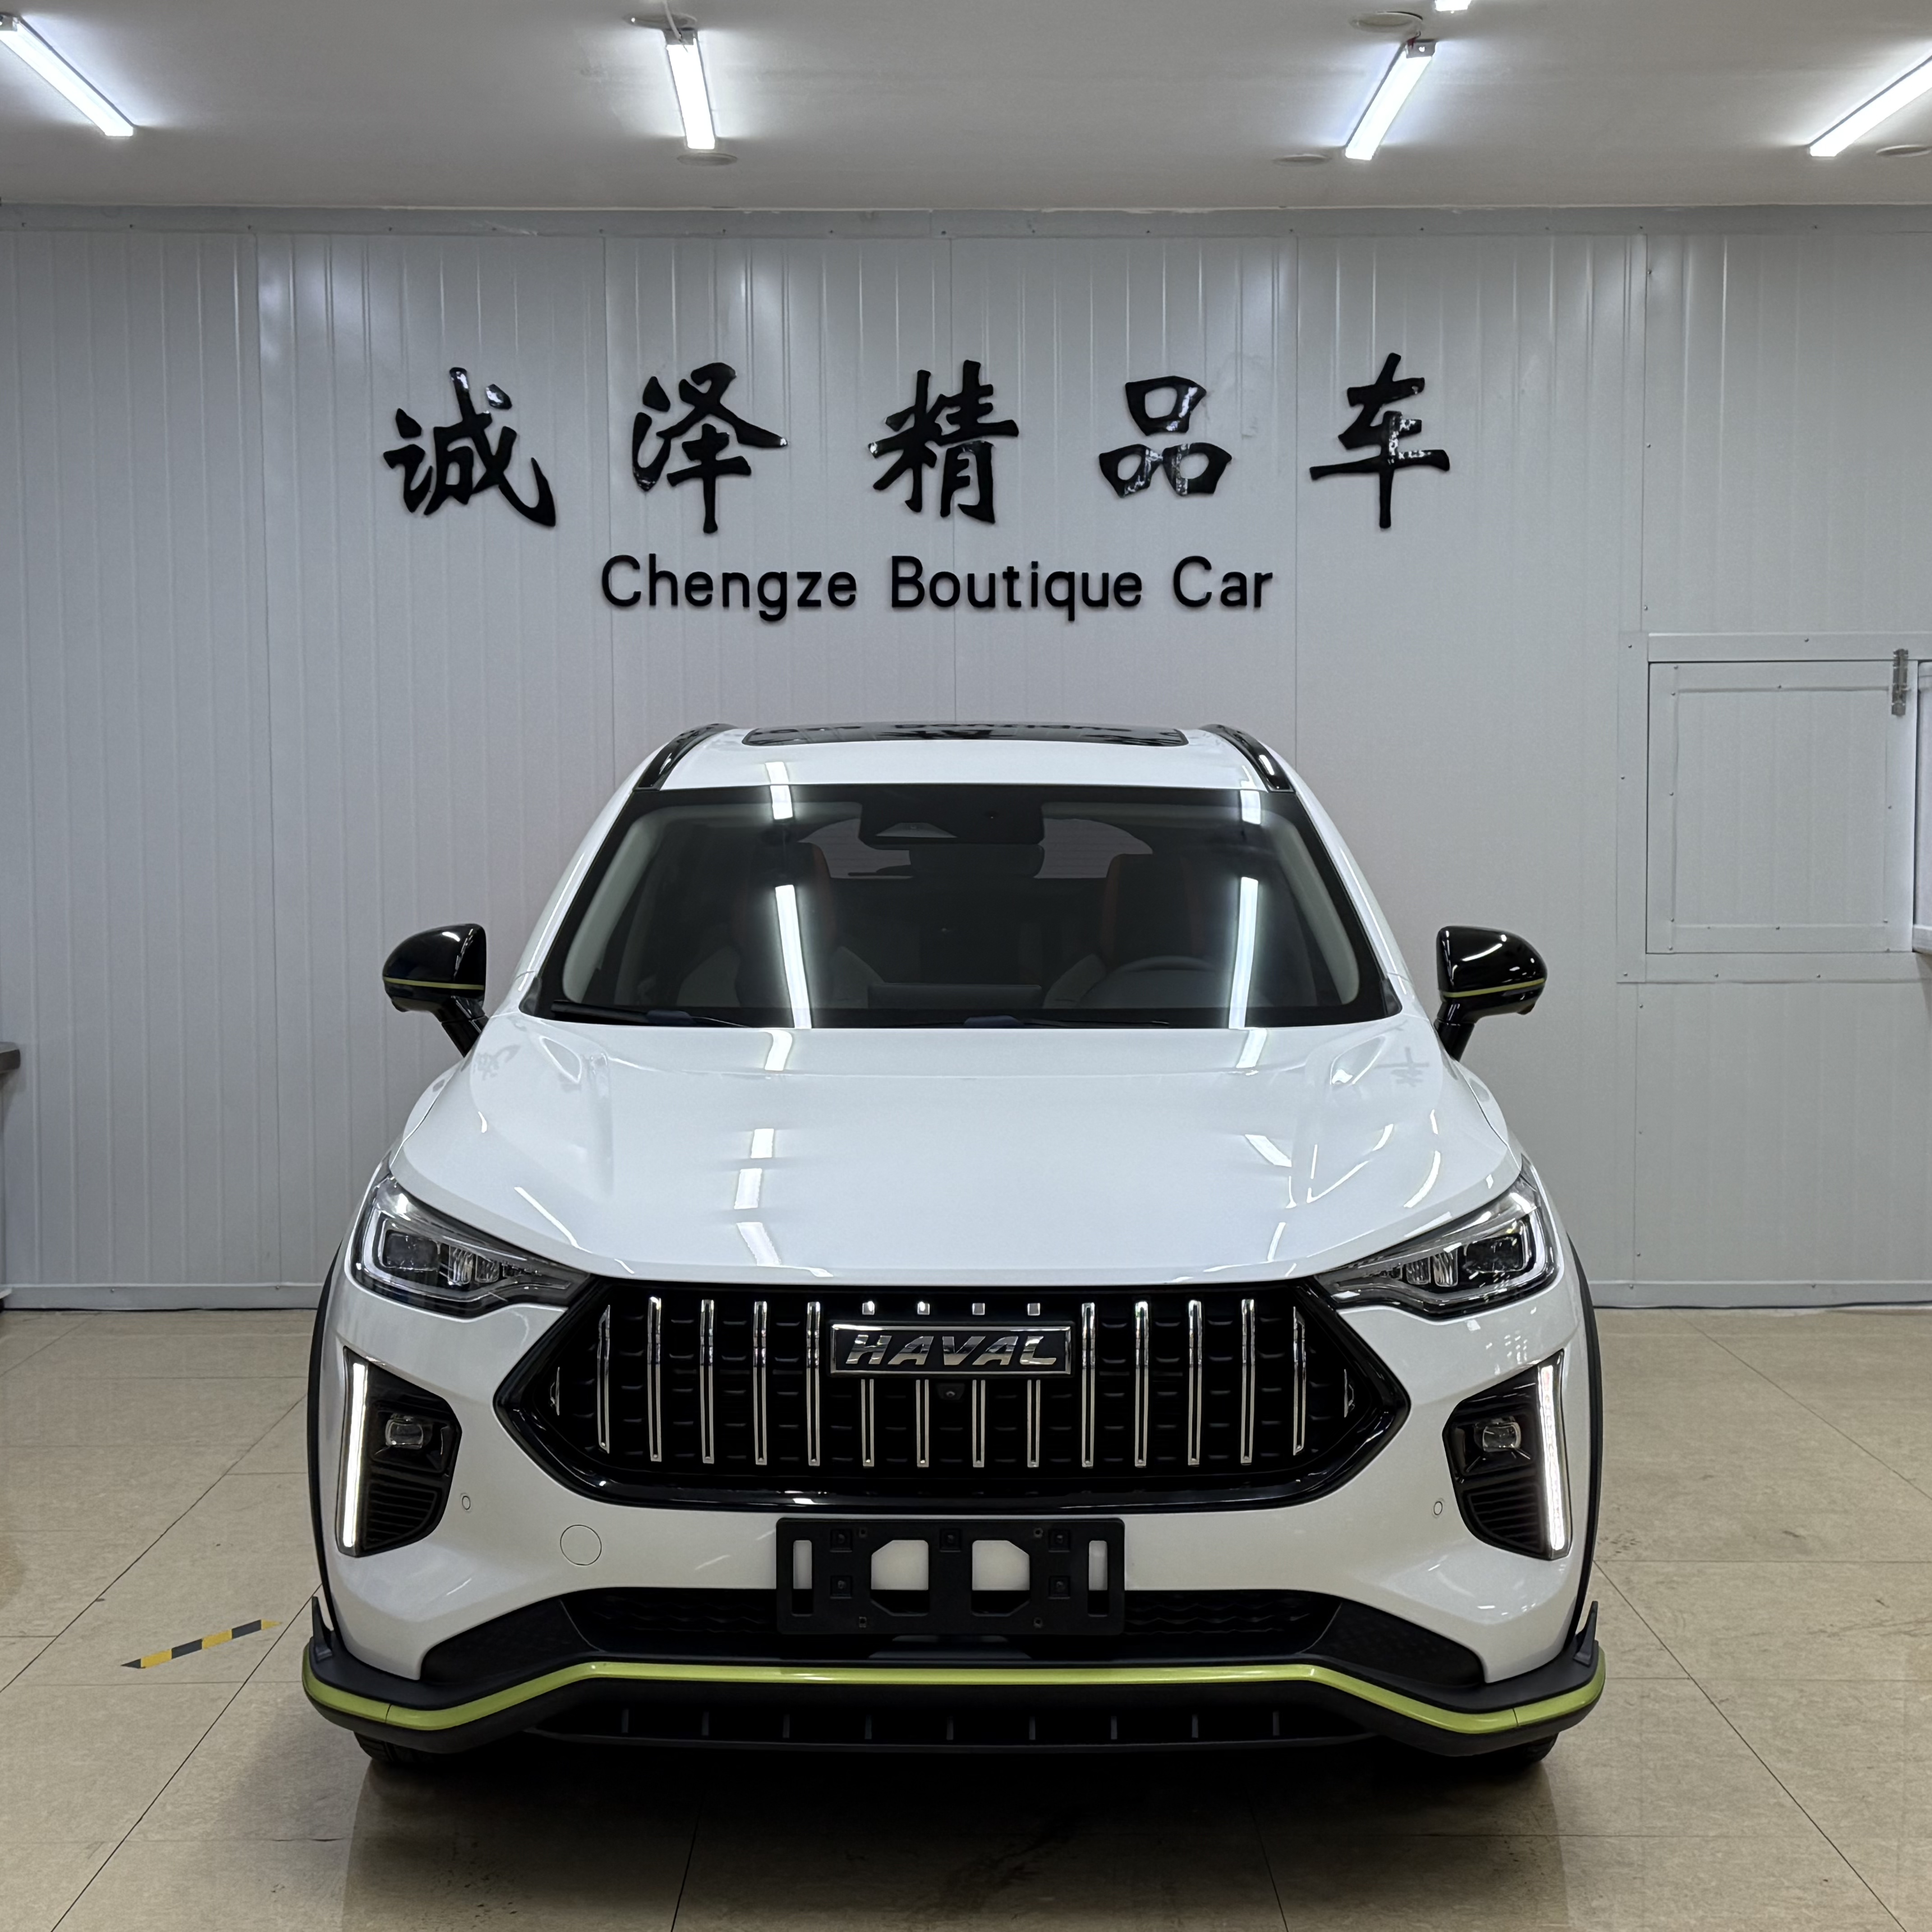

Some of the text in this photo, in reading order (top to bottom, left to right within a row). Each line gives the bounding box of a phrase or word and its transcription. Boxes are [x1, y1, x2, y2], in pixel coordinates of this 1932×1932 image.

[382, 353, 1450, 534] 诚泽精品车
[602, 554, 1273, 622] Chengze Boutique Car
[846, 1334, 1057, 1365] HAVAL
